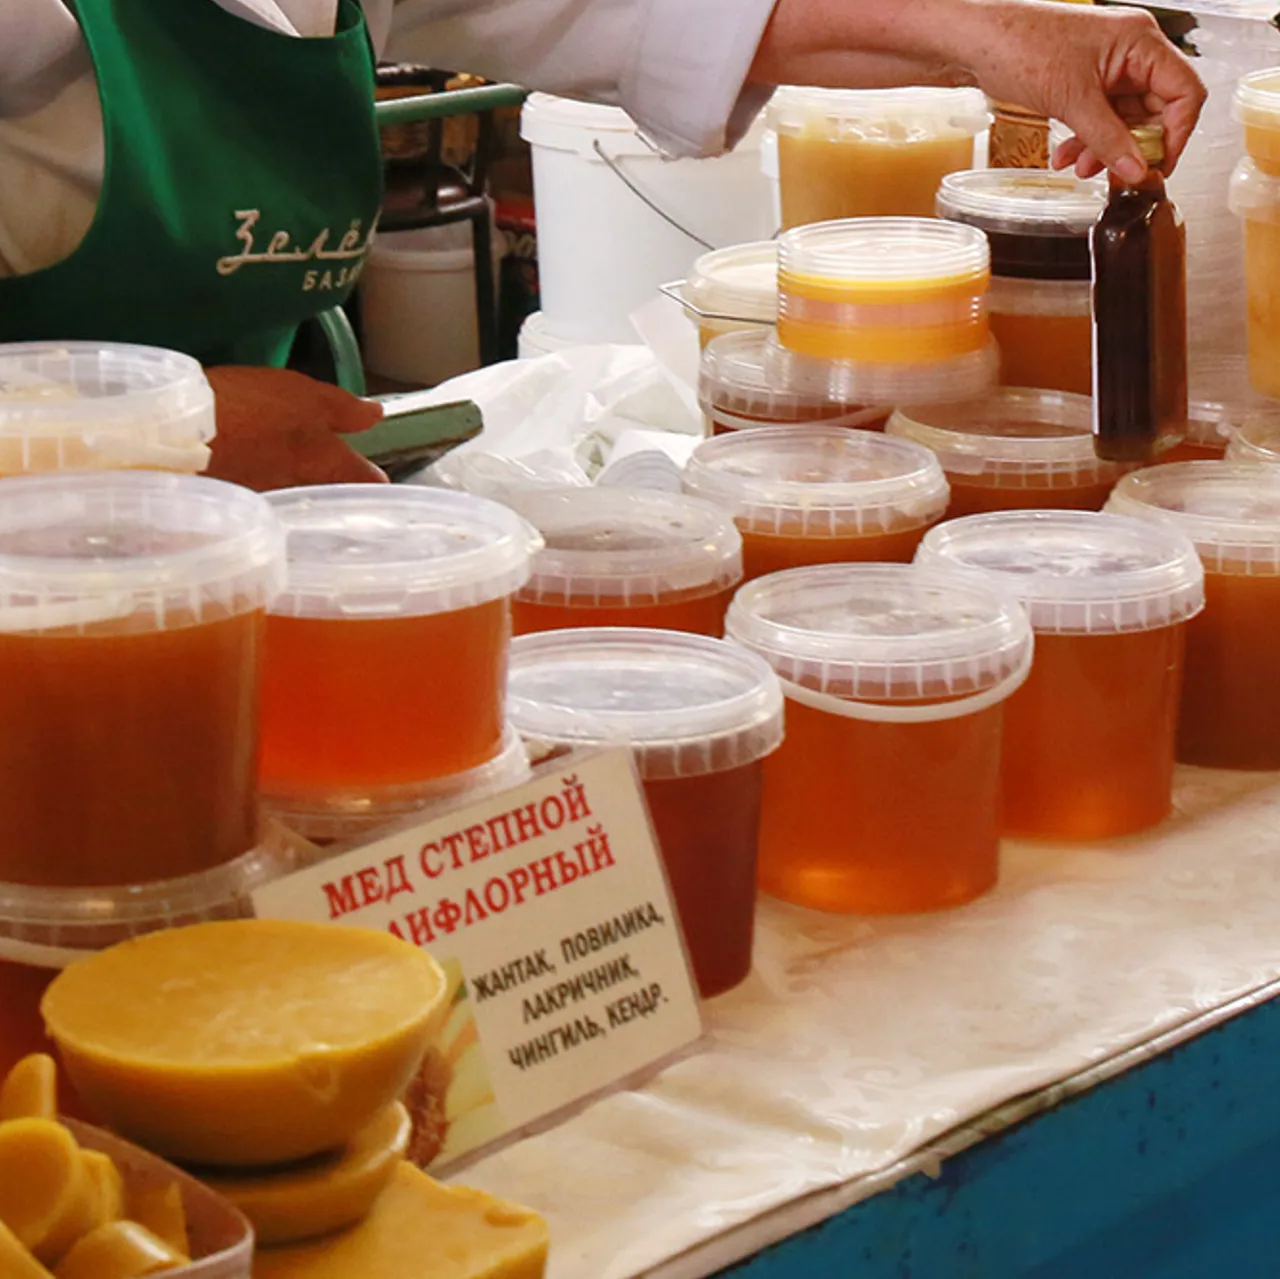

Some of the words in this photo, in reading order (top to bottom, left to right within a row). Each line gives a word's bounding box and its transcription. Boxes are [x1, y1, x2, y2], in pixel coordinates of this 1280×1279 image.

[322, 854, 415, 920] МЕД
[418, 773, 592, 879] СТЕПНОЙ
[471, 948, 558, 1003] ЖАНТАК,
[560, 901, 666, 964] ПОВИЛИКА,
[522, 952, 641, 1024] ЛАКРИЧНИК,
[508, 1015, 608, 1071] ЧИНГИЛЬ,
[604, 981, 670, 1029] КЕНДР.
